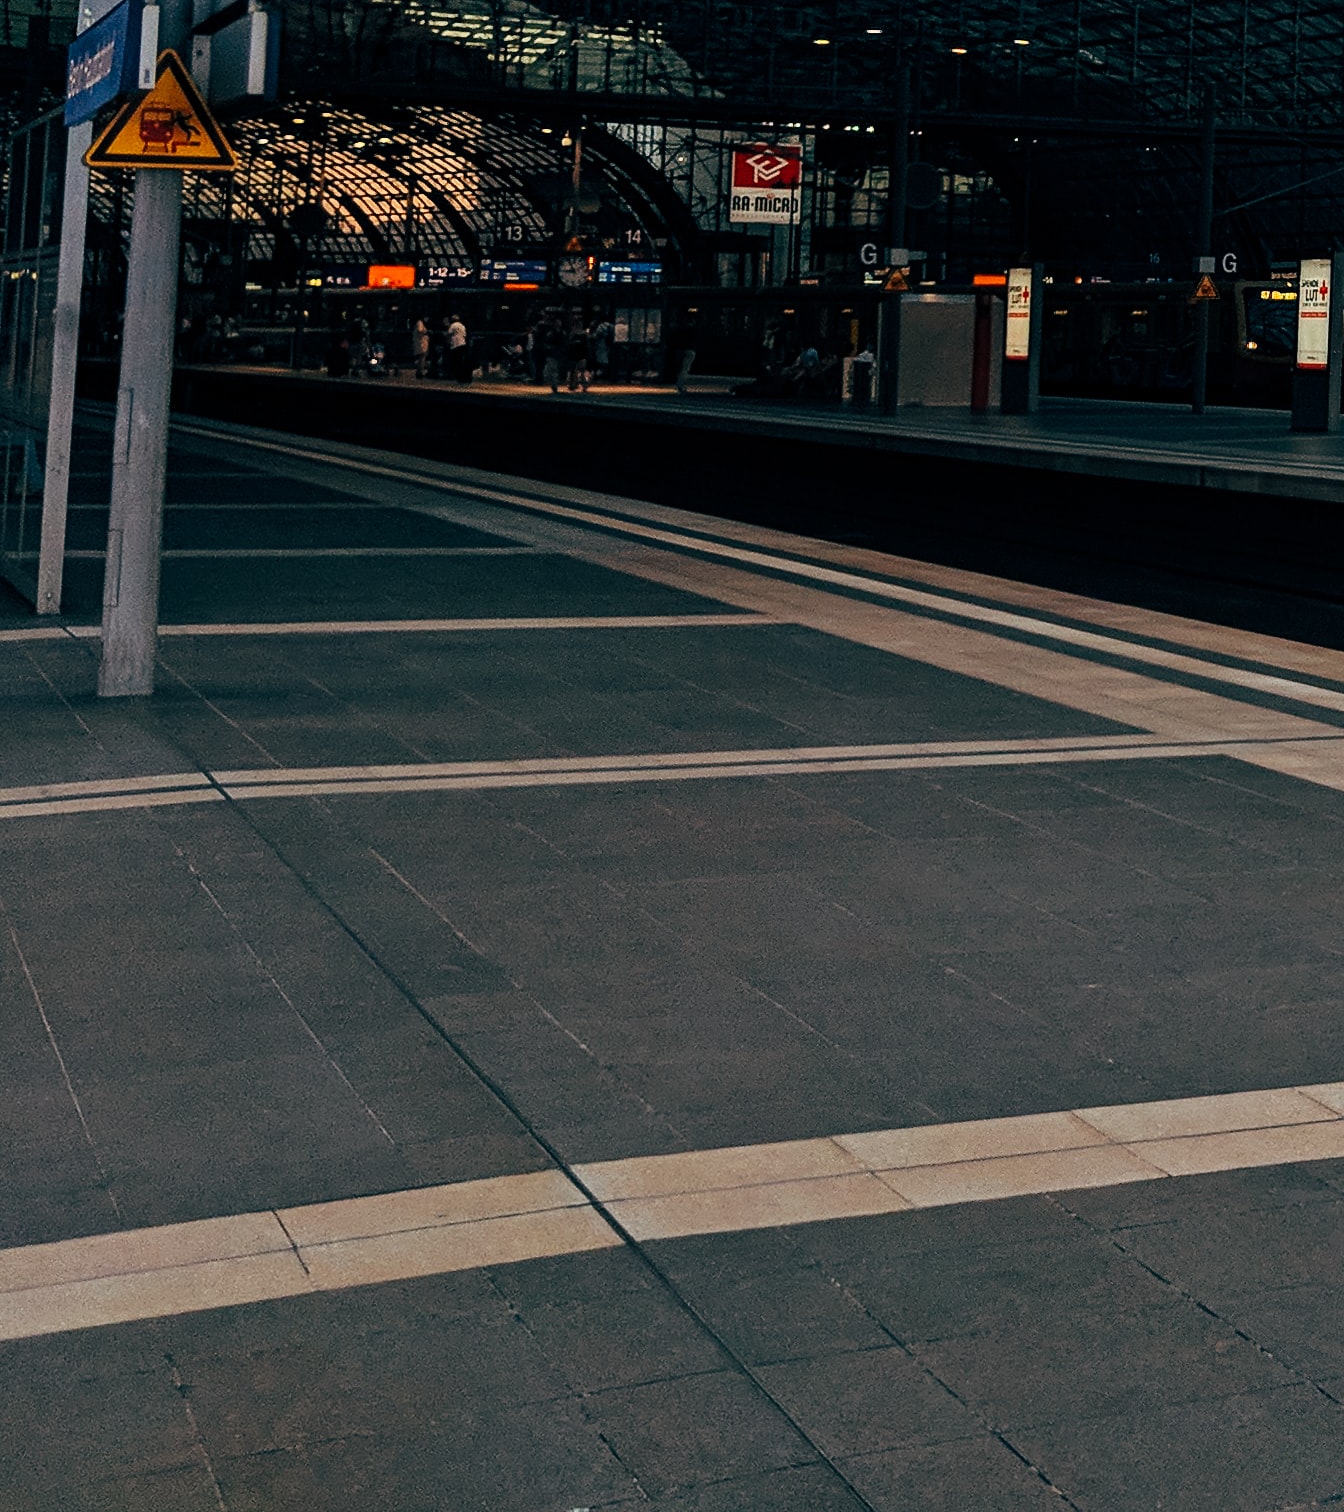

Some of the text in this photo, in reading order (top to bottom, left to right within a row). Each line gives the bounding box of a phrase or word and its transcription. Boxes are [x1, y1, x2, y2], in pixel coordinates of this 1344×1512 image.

[505, 225, 523, 242] 13
[625, 229, 643, 245] 14
[860, 243, 878, 265] G
[1149, 252, 1161, 264] 16
[1222, 253, 1238, 274] G
